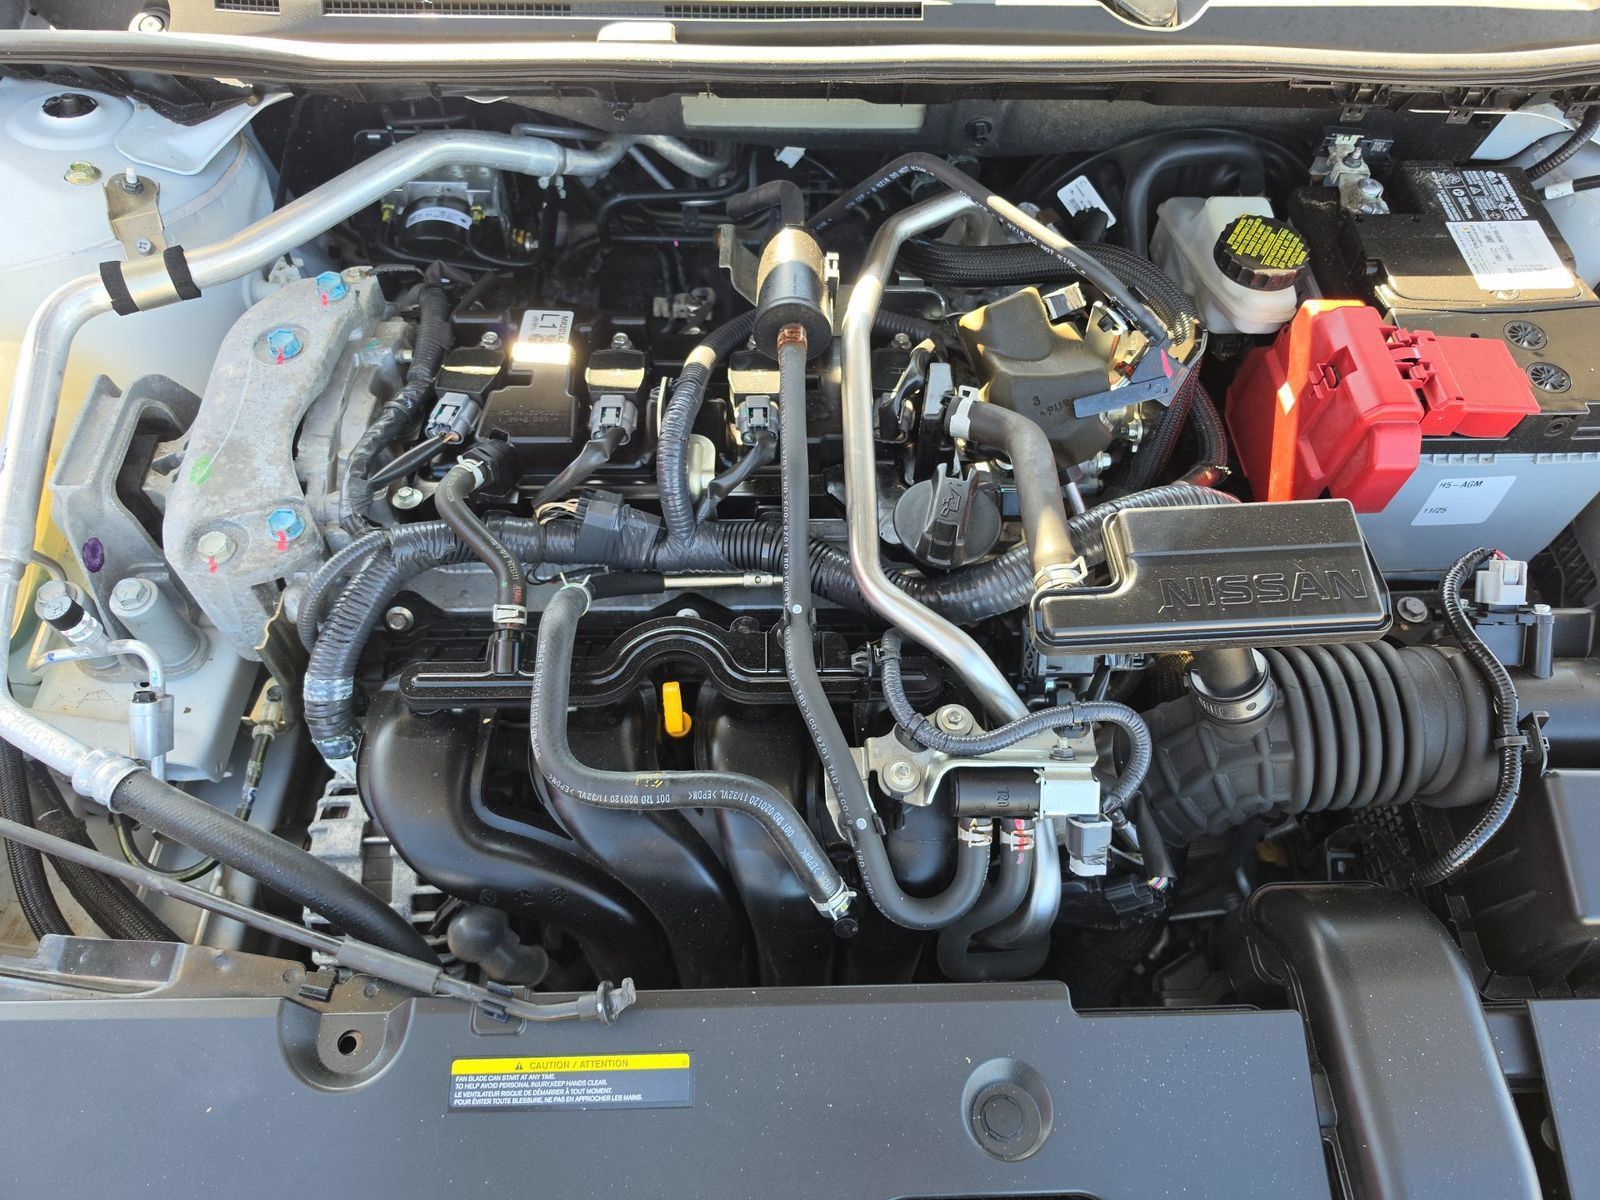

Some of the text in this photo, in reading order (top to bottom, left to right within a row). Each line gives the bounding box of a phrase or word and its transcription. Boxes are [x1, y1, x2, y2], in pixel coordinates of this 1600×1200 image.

[539, 314, 560, 329] L1
[1159, 569, 1368, 608] NISSAN
[577, 790, 608, 803] 11/32VL
[610, 793, 639, 804] 020120
[656, 793, 670, 804] DOT
[719, 790, 749, 802] 11/32VL
[749, 795, 775, 816] 020120
[530, 1061, 570, 1070] CAUTION
[580, 1059, 629, 1068] ATTENTION
[462, 1090, 500, 1098] VENTILATEUR
[532, 1088, 565, 1096] DÉMARRER
[454, 1098, 472, 1106] POUR
[472, 1097, 492, 1105] ÉVITER
[574, 1094, 612, 1102] APPROCHER
